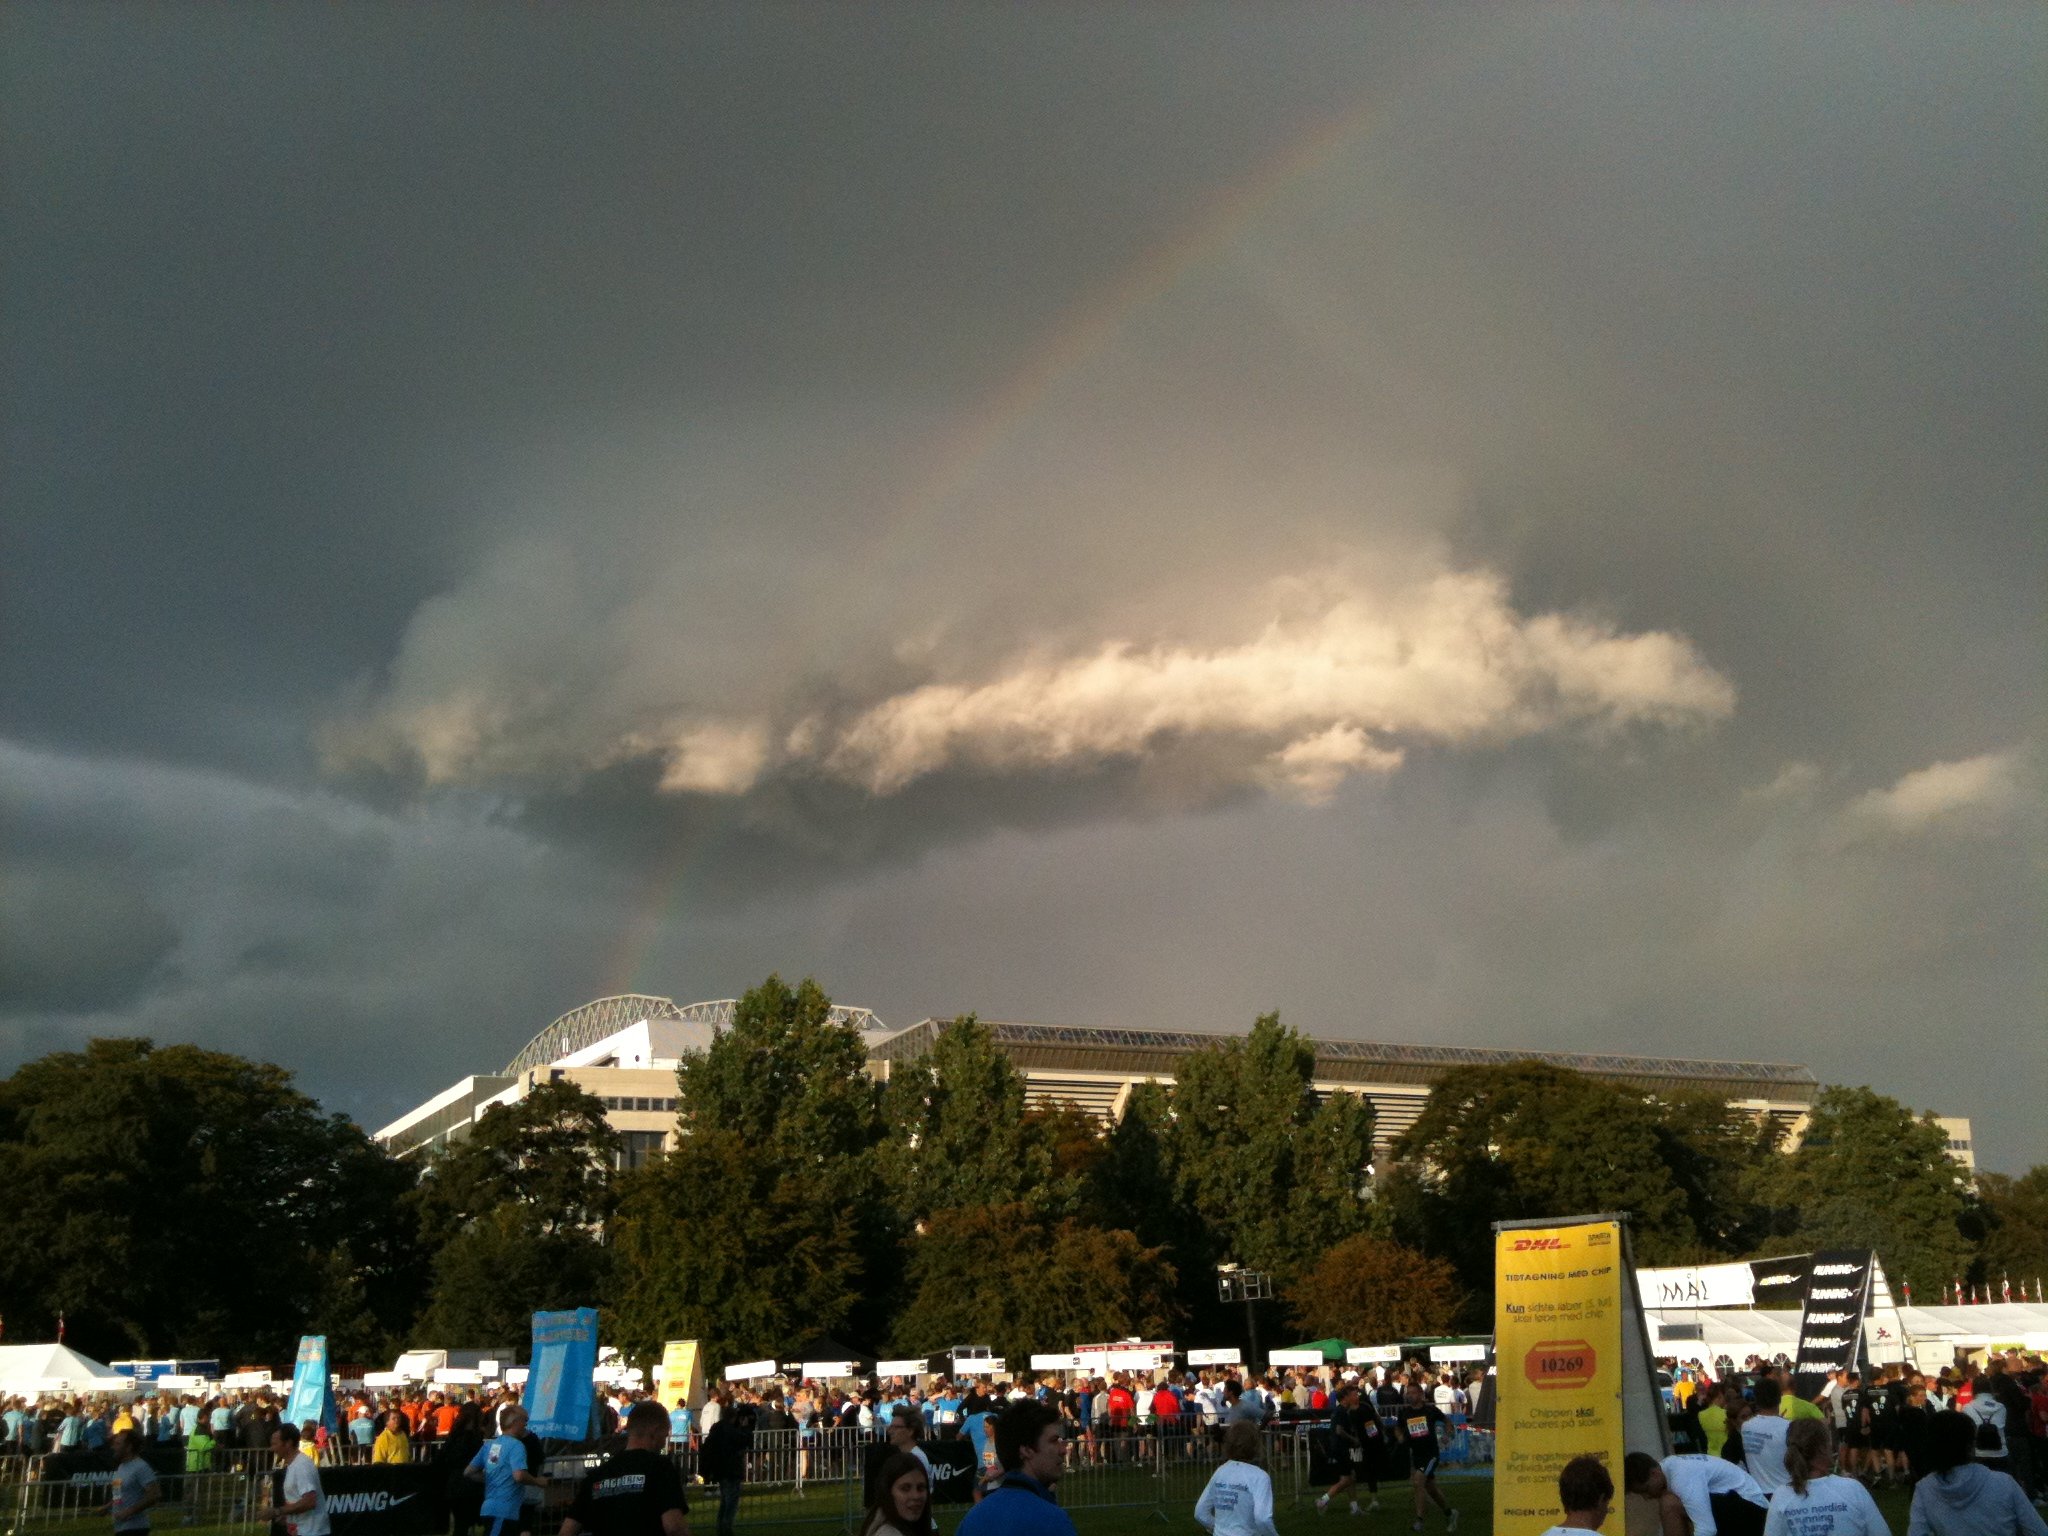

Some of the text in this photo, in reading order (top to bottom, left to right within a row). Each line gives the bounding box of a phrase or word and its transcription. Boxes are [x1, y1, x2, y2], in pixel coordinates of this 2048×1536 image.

[1512, 1238, 1563, 1252] DHL
[1505, 1303, 1525, 1314] Kun
[1541, 1356, 1584, 1373] 10269
[1530, 1406, 1595, 1419] Chippen skal
[1784, 1502, 1848, 1517] novo nordisk
